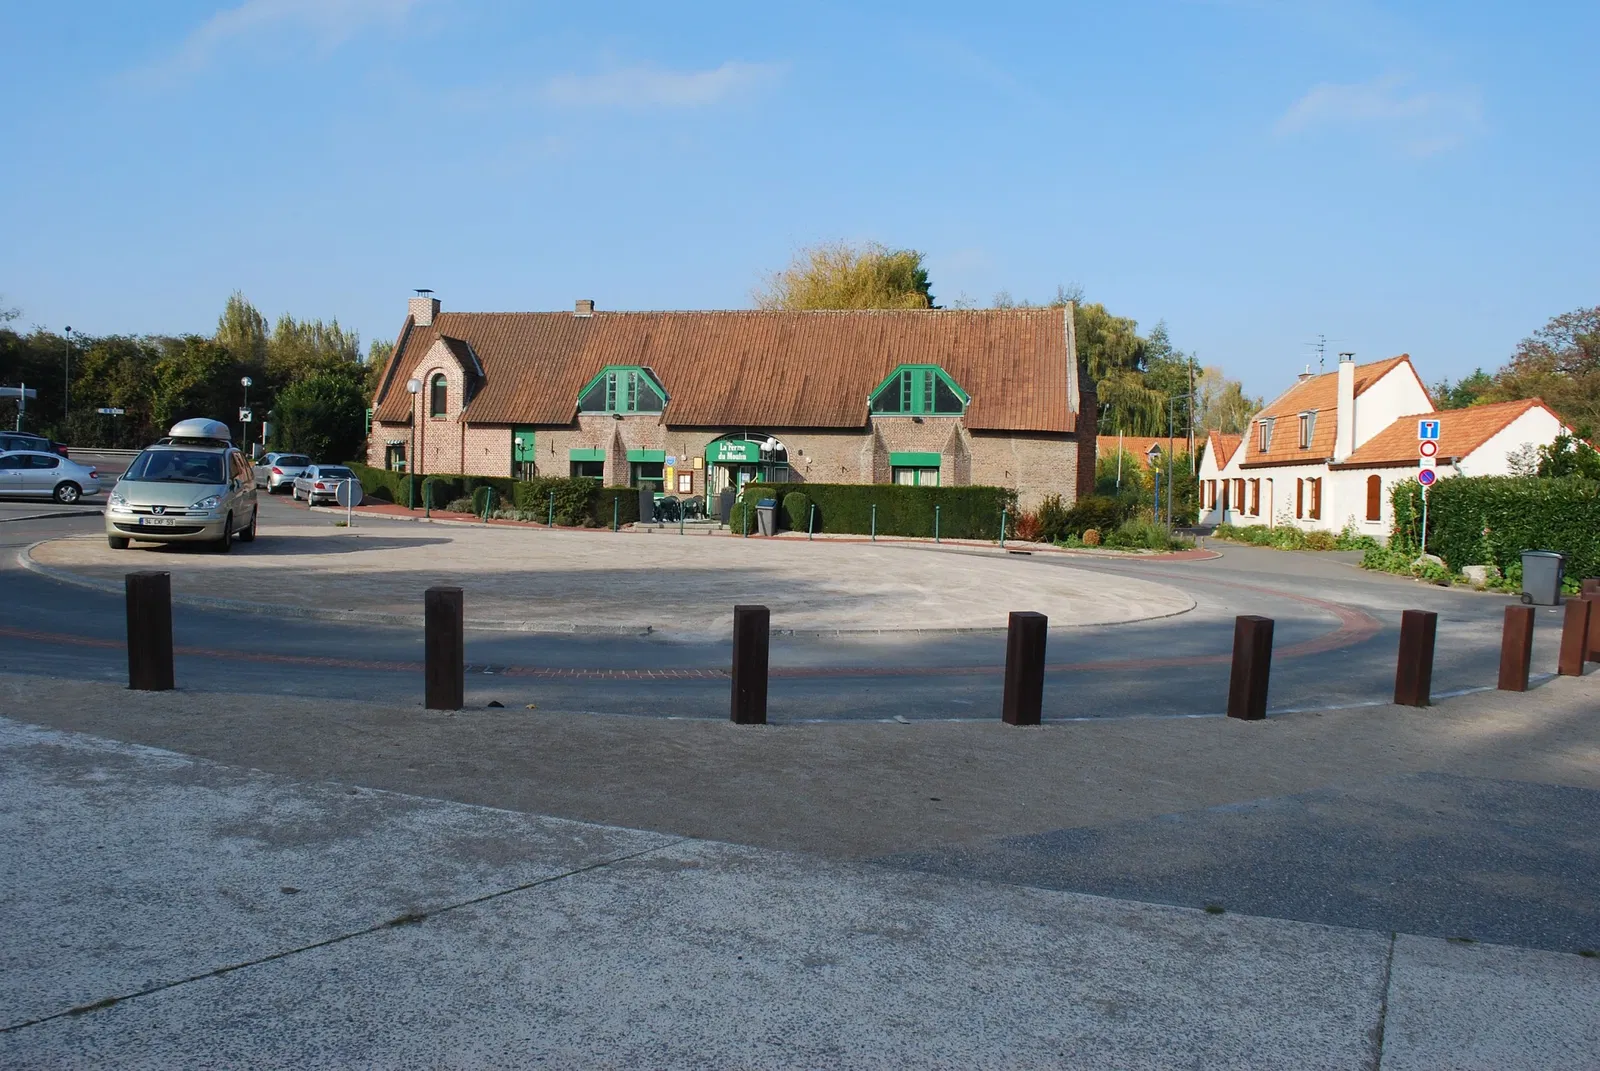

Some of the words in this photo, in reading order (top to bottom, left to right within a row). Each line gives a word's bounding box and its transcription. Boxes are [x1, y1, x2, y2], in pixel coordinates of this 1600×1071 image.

[720, 443, 727, 451] La
[728, 443, 745, 451] Ferme
[718, 451, 726, 460] du
[727, 451, 747, 460] Moulin
